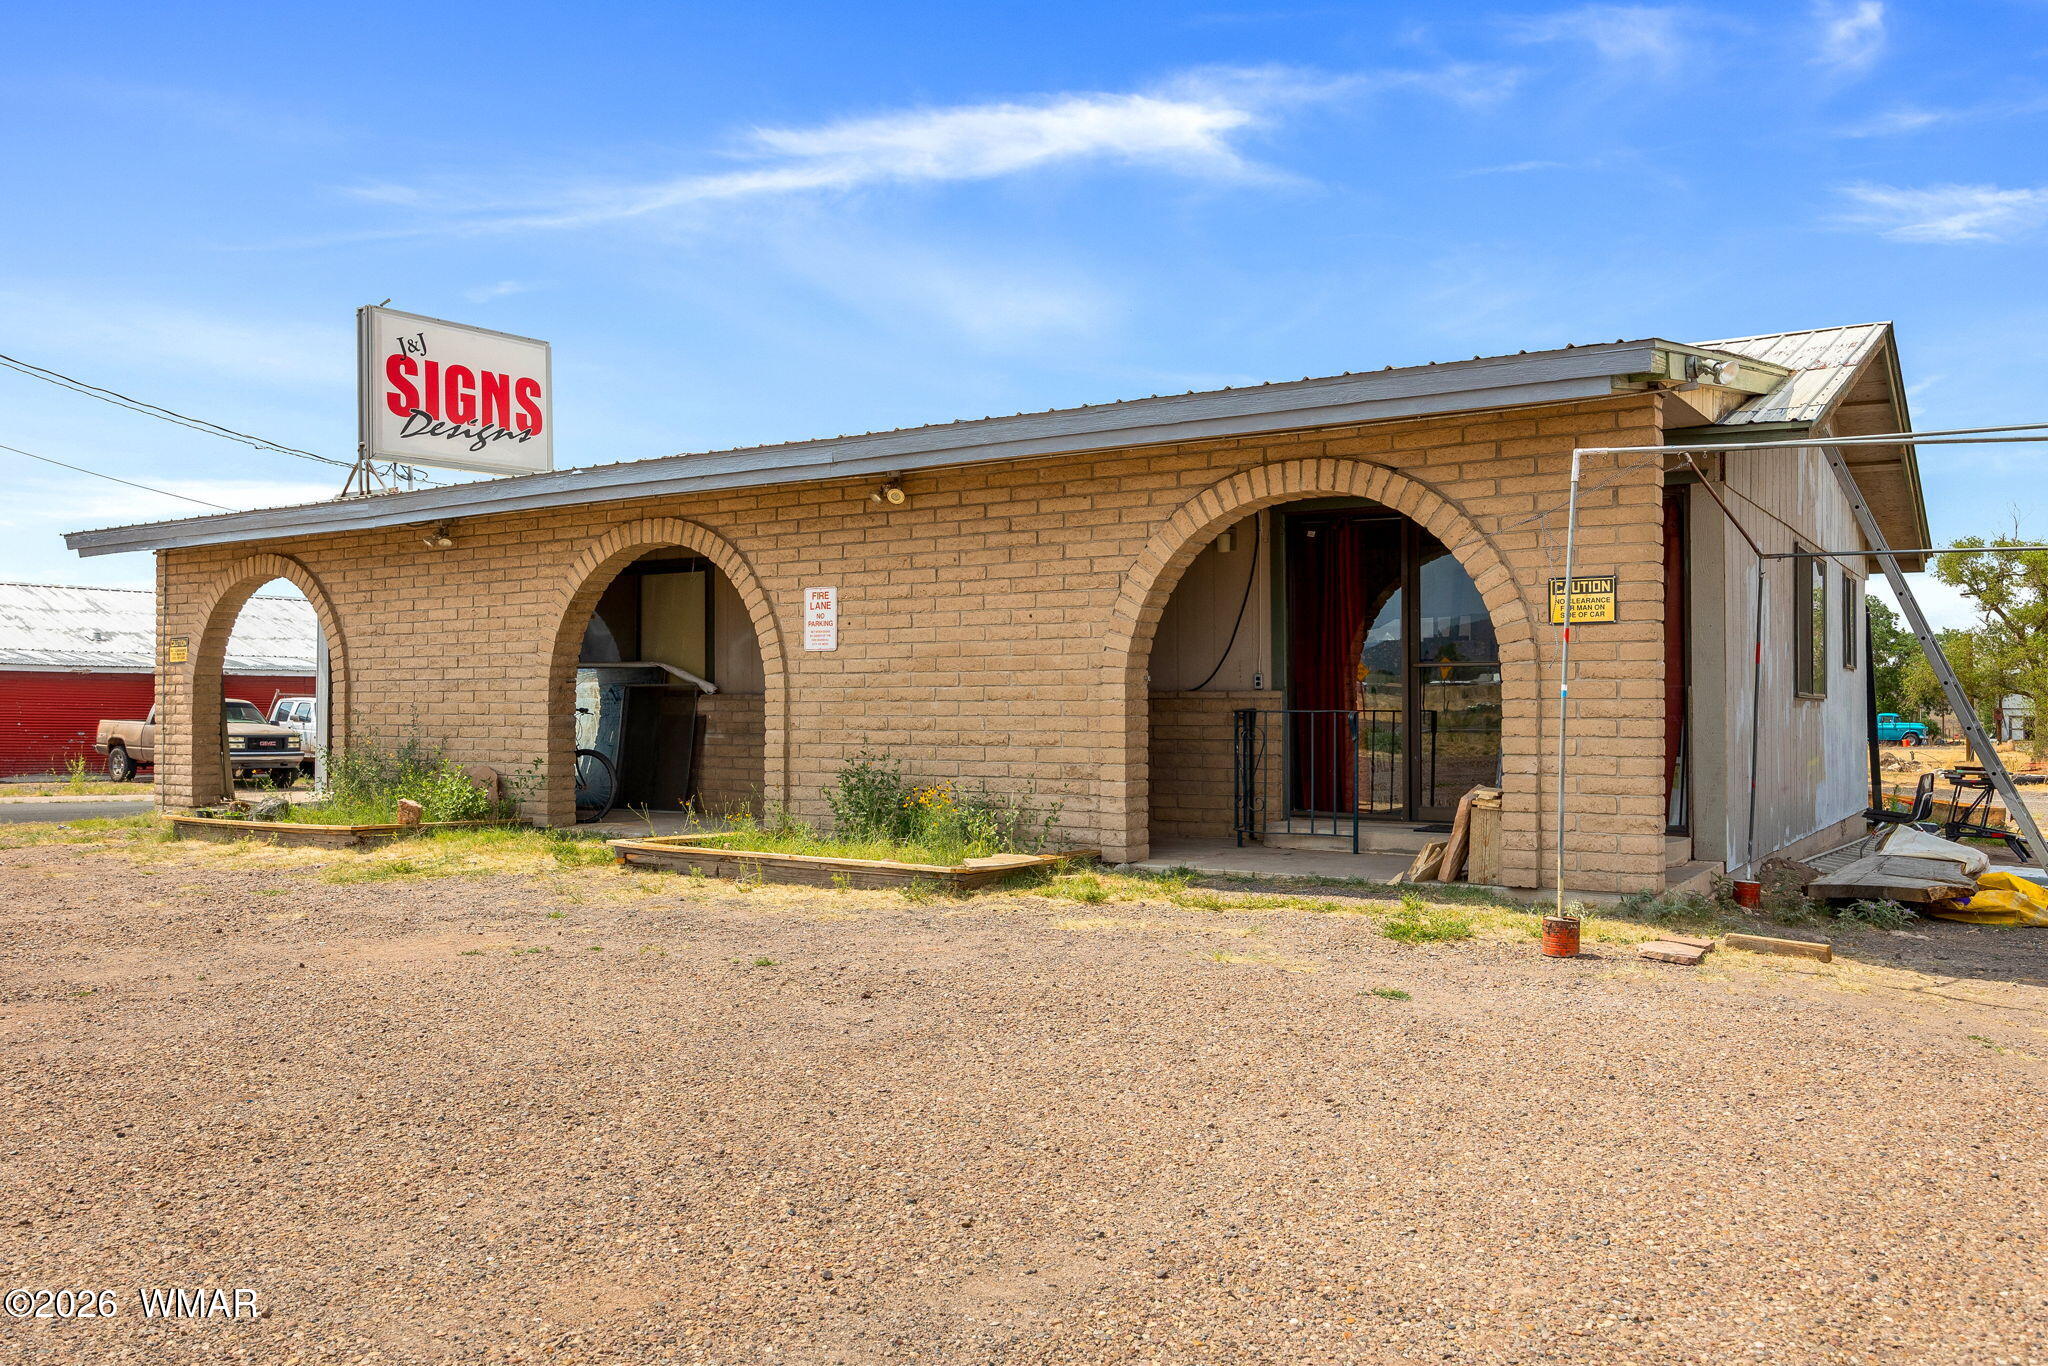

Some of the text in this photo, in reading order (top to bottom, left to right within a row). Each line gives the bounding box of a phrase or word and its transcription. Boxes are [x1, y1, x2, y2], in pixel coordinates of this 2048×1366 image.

[396, 332, 428, 361] J&J
[386, 353, 543, 437] SIGNS
[400, 408, 532, 452] Designs
[811, 591, 830, 600] FIRE
[1555, 580, 1611, 594] CUTION
[809, 601, 831, 610] LANE
